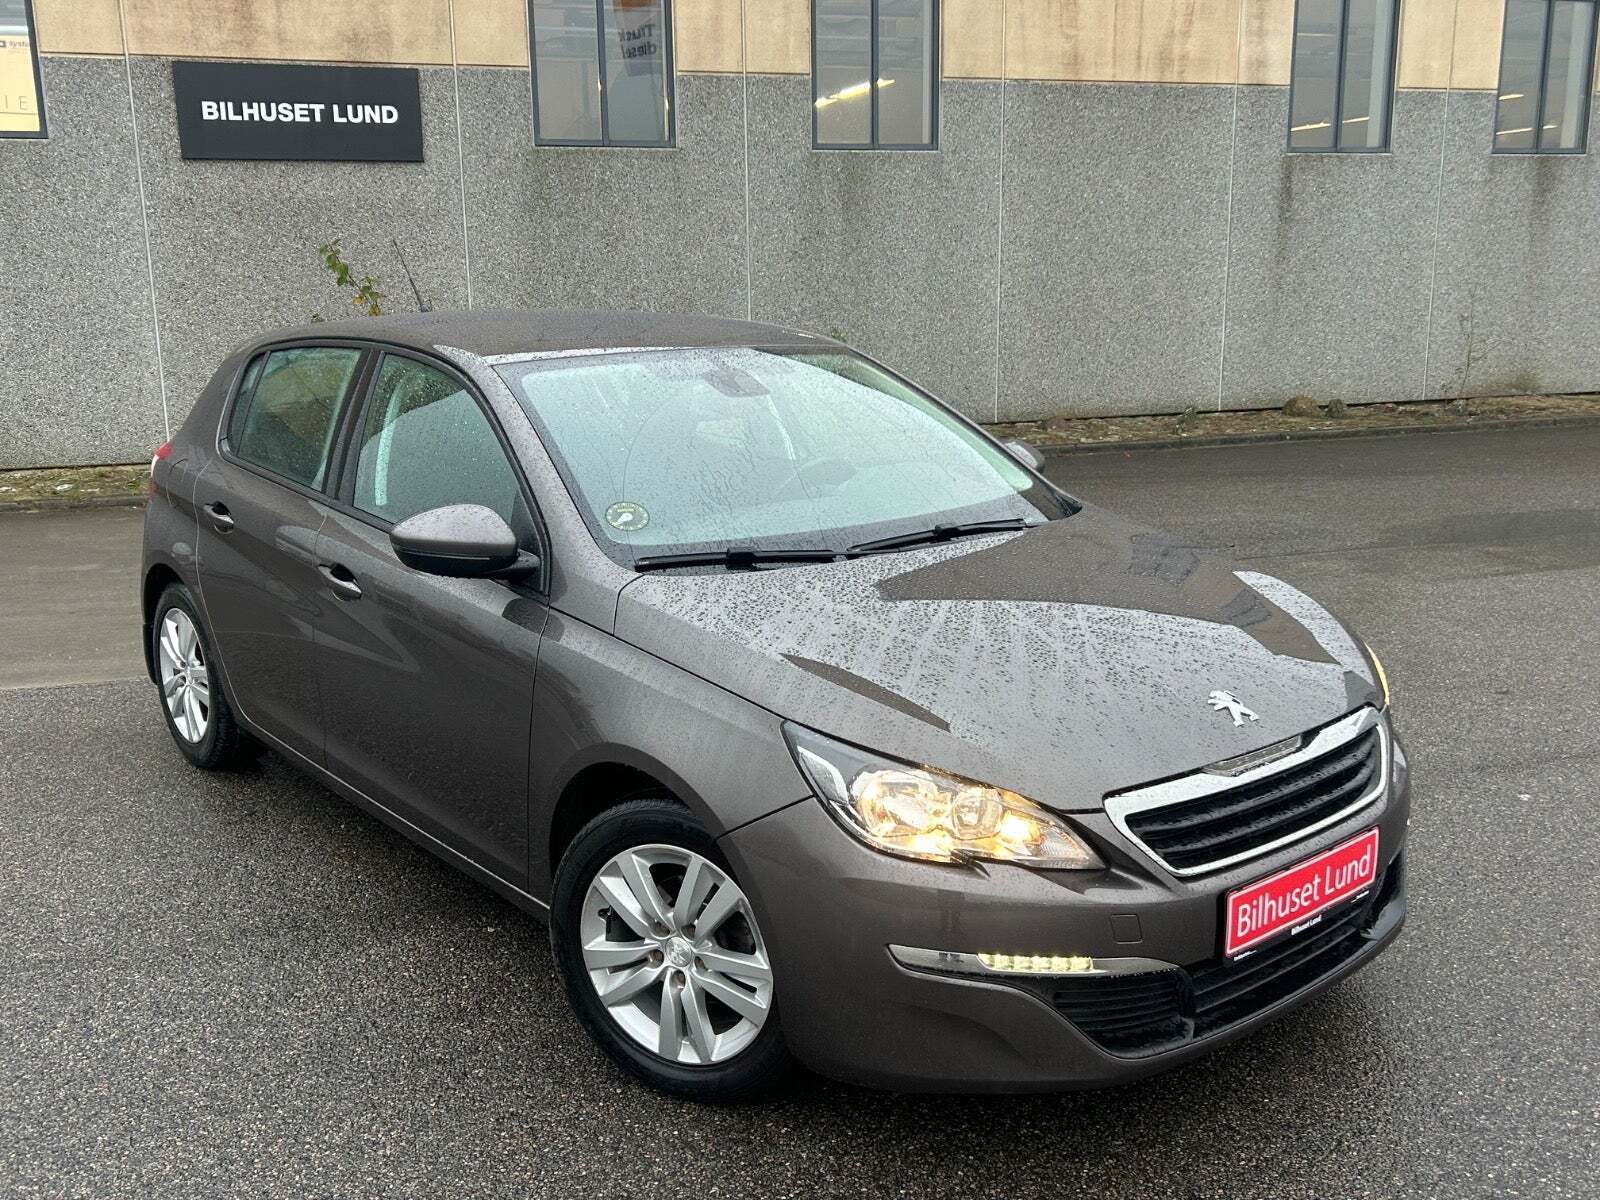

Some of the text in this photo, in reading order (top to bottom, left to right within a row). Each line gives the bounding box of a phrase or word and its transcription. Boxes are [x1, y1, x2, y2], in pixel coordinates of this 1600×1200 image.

[201, 101, 399, 124] BILHUSET LUND
[1237, 843, 1372, 938] Bilhuset Lund
